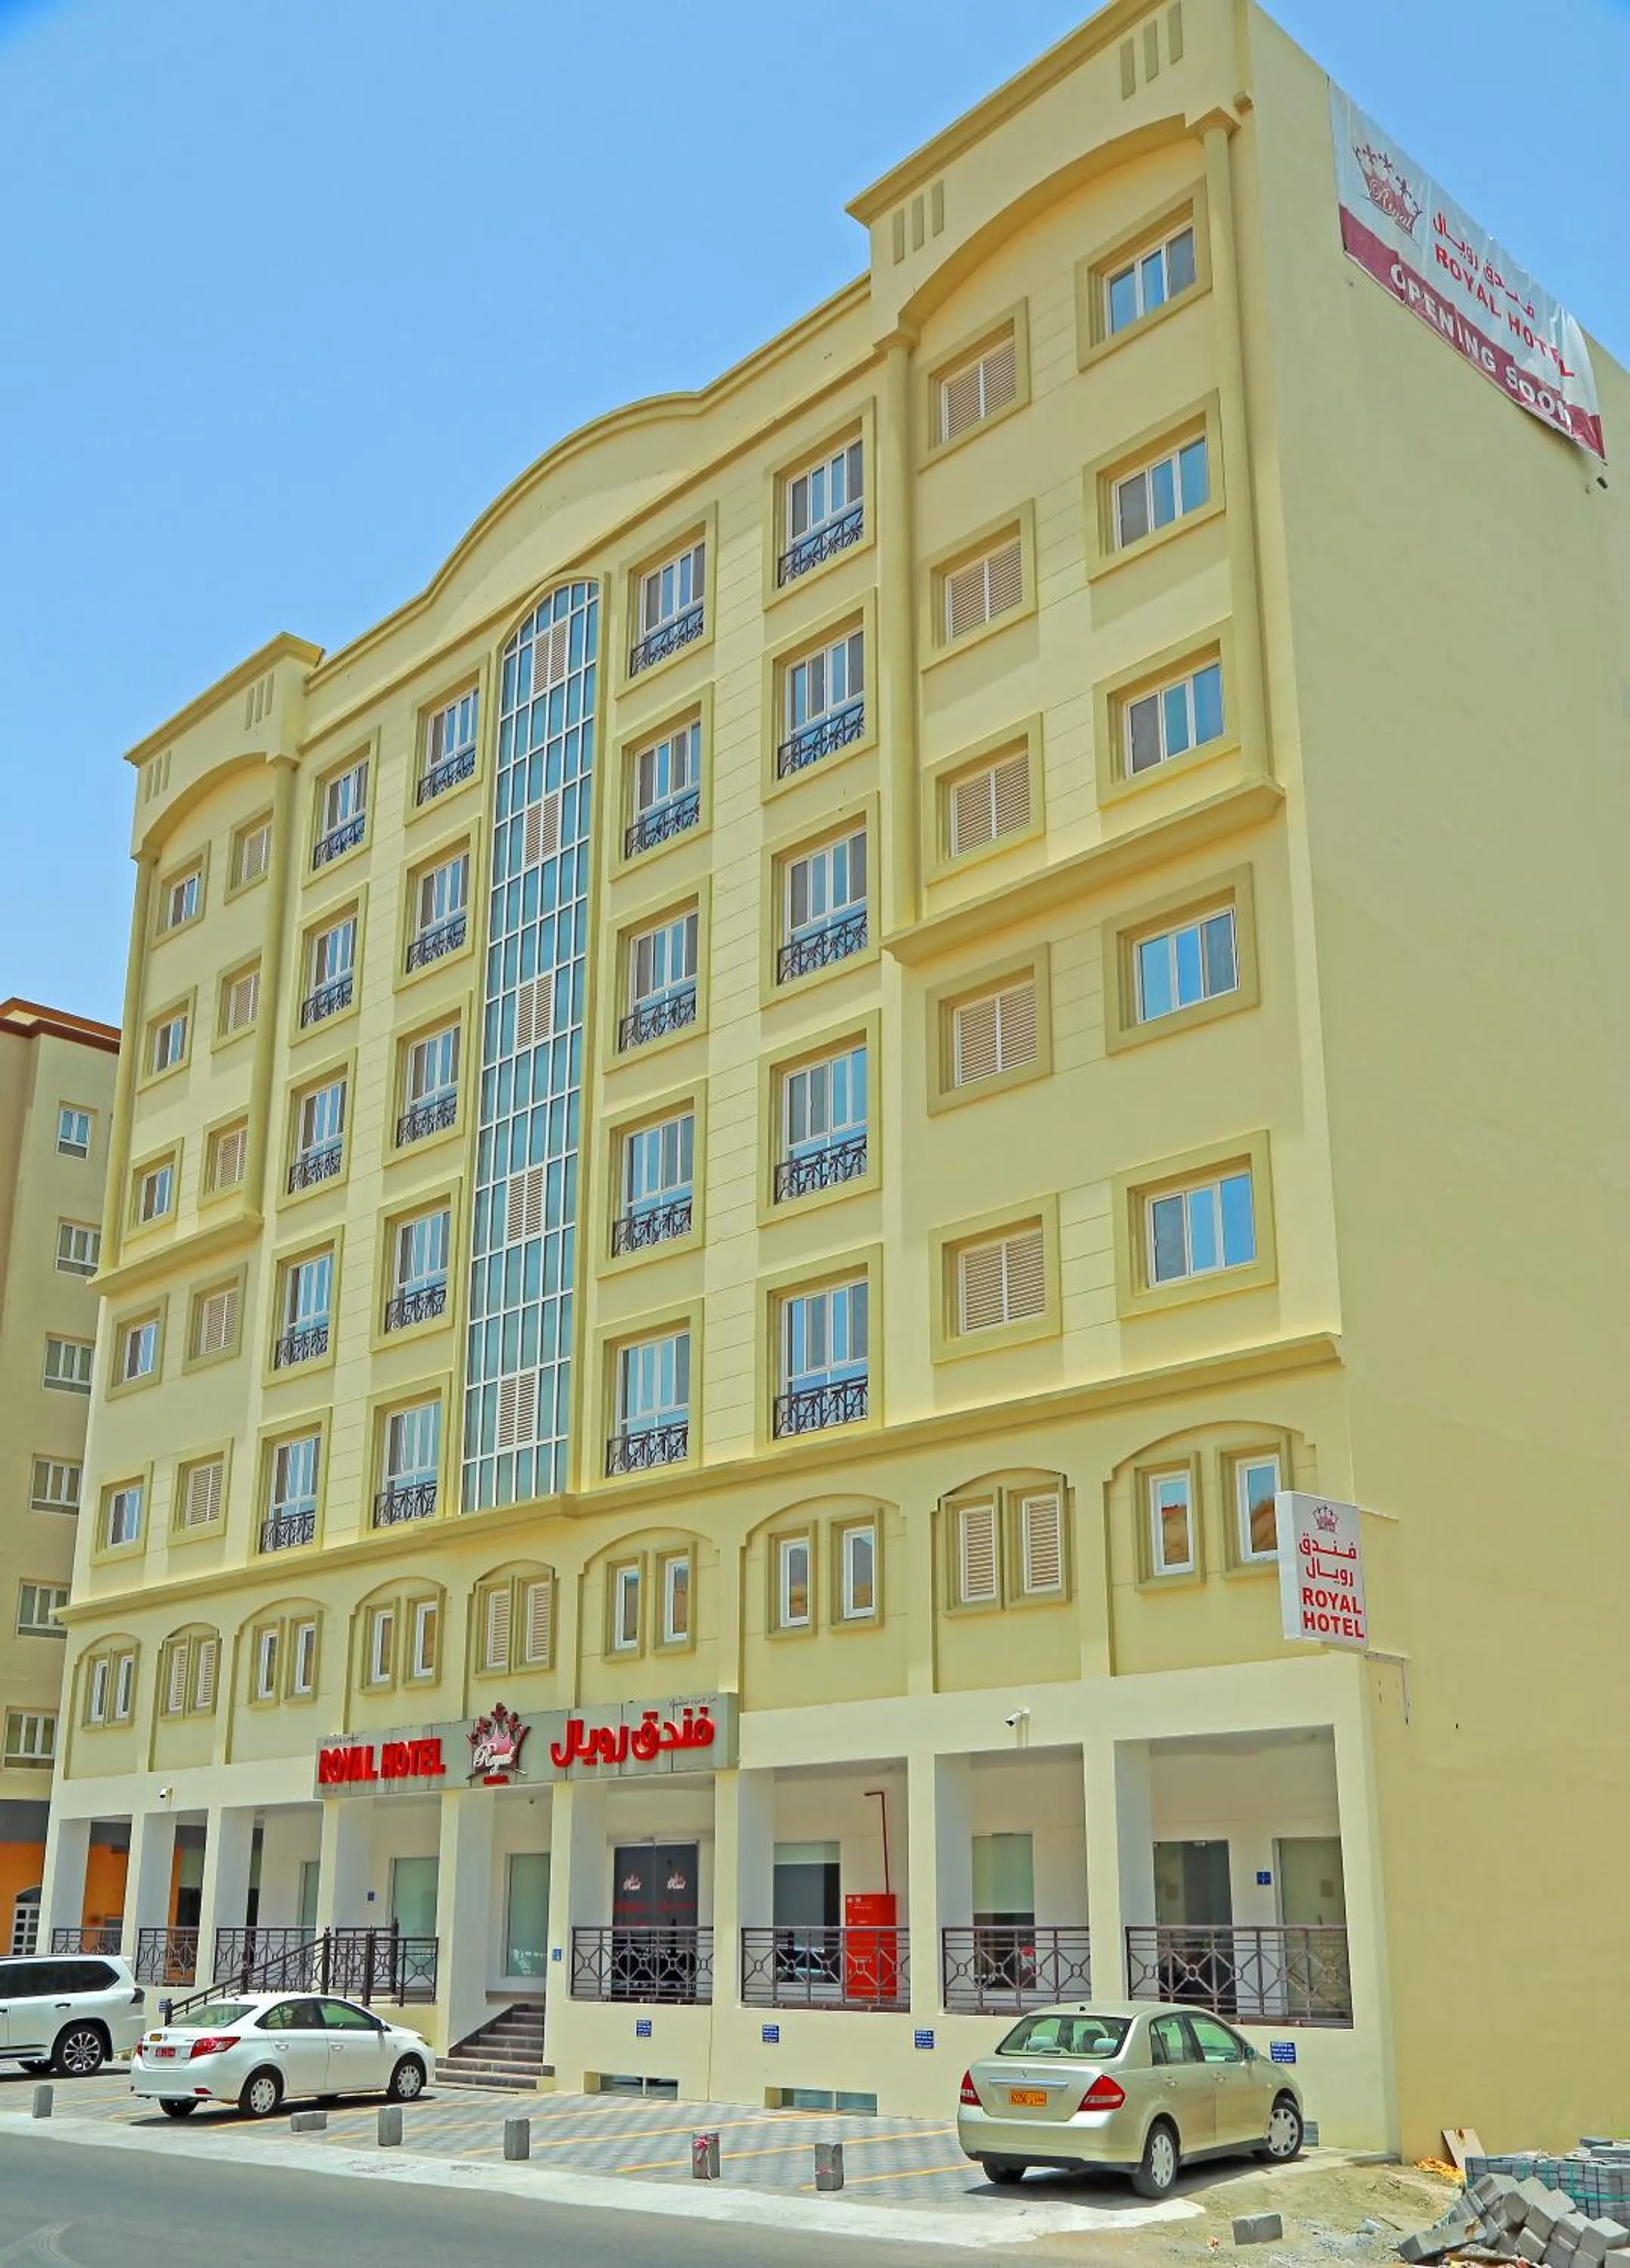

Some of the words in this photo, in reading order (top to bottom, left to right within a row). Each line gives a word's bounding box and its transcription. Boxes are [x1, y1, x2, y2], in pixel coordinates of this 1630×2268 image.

[1435, 242, 1501, 318] ROYAL
[1508, 311, 1575, 377] HOTEL
[1390, 264, 1496, 373] OPENING
[1505, 364, 1573, 435] SOON
[1302, 1587, 1362, 1615] ROYAL
[1303, 1611, 1365, 1638] HOTEL
[550, 1718, 630, 1768] رويال
[631, 1706, 715, 1761] فندق
[318, 1746, 378, 1784] ROYAL
[380, 1737, 446, 1779] HOTEL
